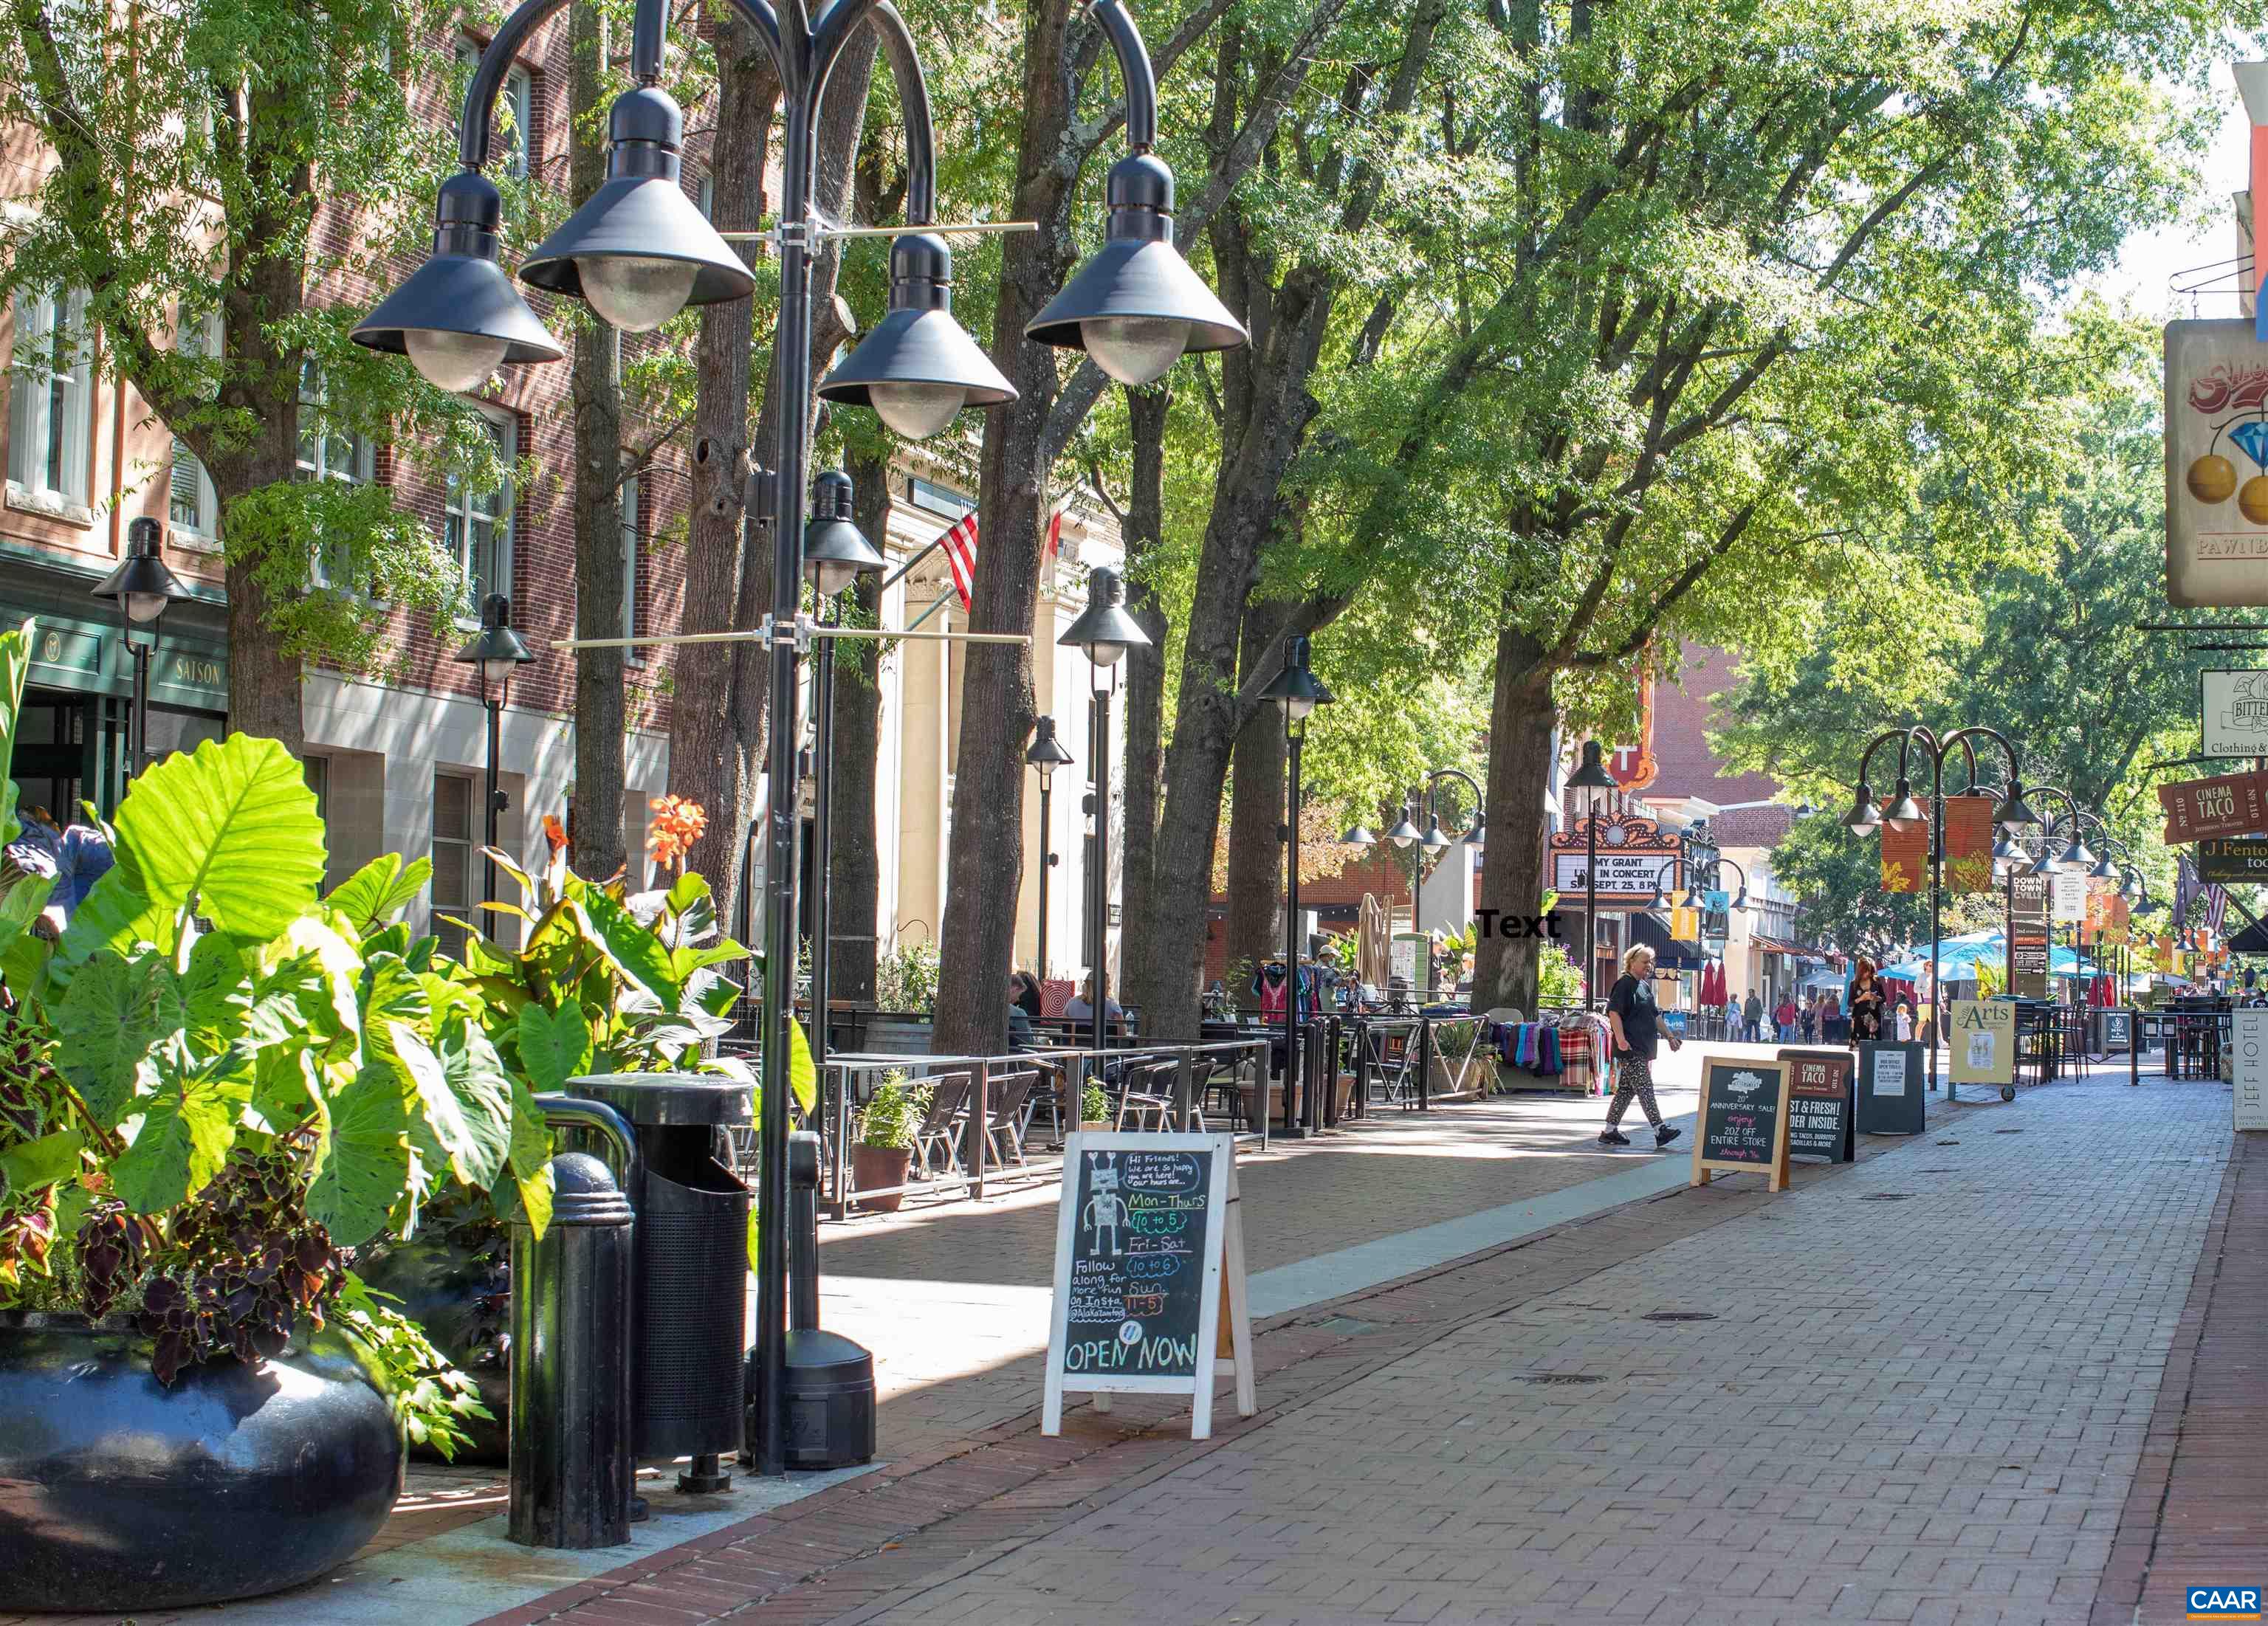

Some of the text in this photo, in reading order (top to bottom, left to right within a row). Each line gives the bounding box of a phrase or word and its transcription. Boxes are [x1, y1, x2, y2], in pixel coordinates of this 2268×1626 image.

[176, 657, 220, 686] SAISON
[2236, 701, 2268, 717] BITTE
[2211, 743, 2268, 755] Clothing &
[2196, 785, 2233, 801] CINEMA
[2197, 797, 2235, 819] TACO
[2205, 841, 2216, 856] J
[1612, 858, 1643, 867] GRANT
[1599, 869, 1609, 878] IN
[1612, 869, 1655, 878] CONCERT
[1639, 881, 1646, 889] 8
[2013, 877, 2042, 885] DOWN
[2013, 884, 2042, 892] TOWN
[1962, 1005, 2009, 1029] Arts
[2242, 1016, 2259, 1067] HOTEL
[1802, 1064, 1826, 1073] CINEMA
[1801, 1072, 1825, 1084] TACO
[2244, 1075, 2261, 1108] JEFF
[1710, 1102, 1755, 1112] ANNIVERSARY
[1790, 1100, 1841, 1115] ST & FRESH!
[1790, 1115, 1841, 1130] DER INSIDE.
[1742, 1127, 1757, 1137] OFF
[1711, 1135, 1767, 1147] ENTIRE STORE
[1130, 1155, 1141, 1164] Hi
[1172, 1163, 1193, 1175] happy
[1127, 1174, 1140, 1184] you
[1155, 1171, 1175, 1179] here!
[1136, 1213, 1177, 1226] 10 to 5
[1076, 1260, 1116, 1275] Follow
[1133, 1258, 1171, 1272] 10 to 6
[1072, 1272, 1127, 1289] along for
[1102, 1284, 1121, 1294] fun
[1066, 1333, 1196, 1371] OPEN NOW
